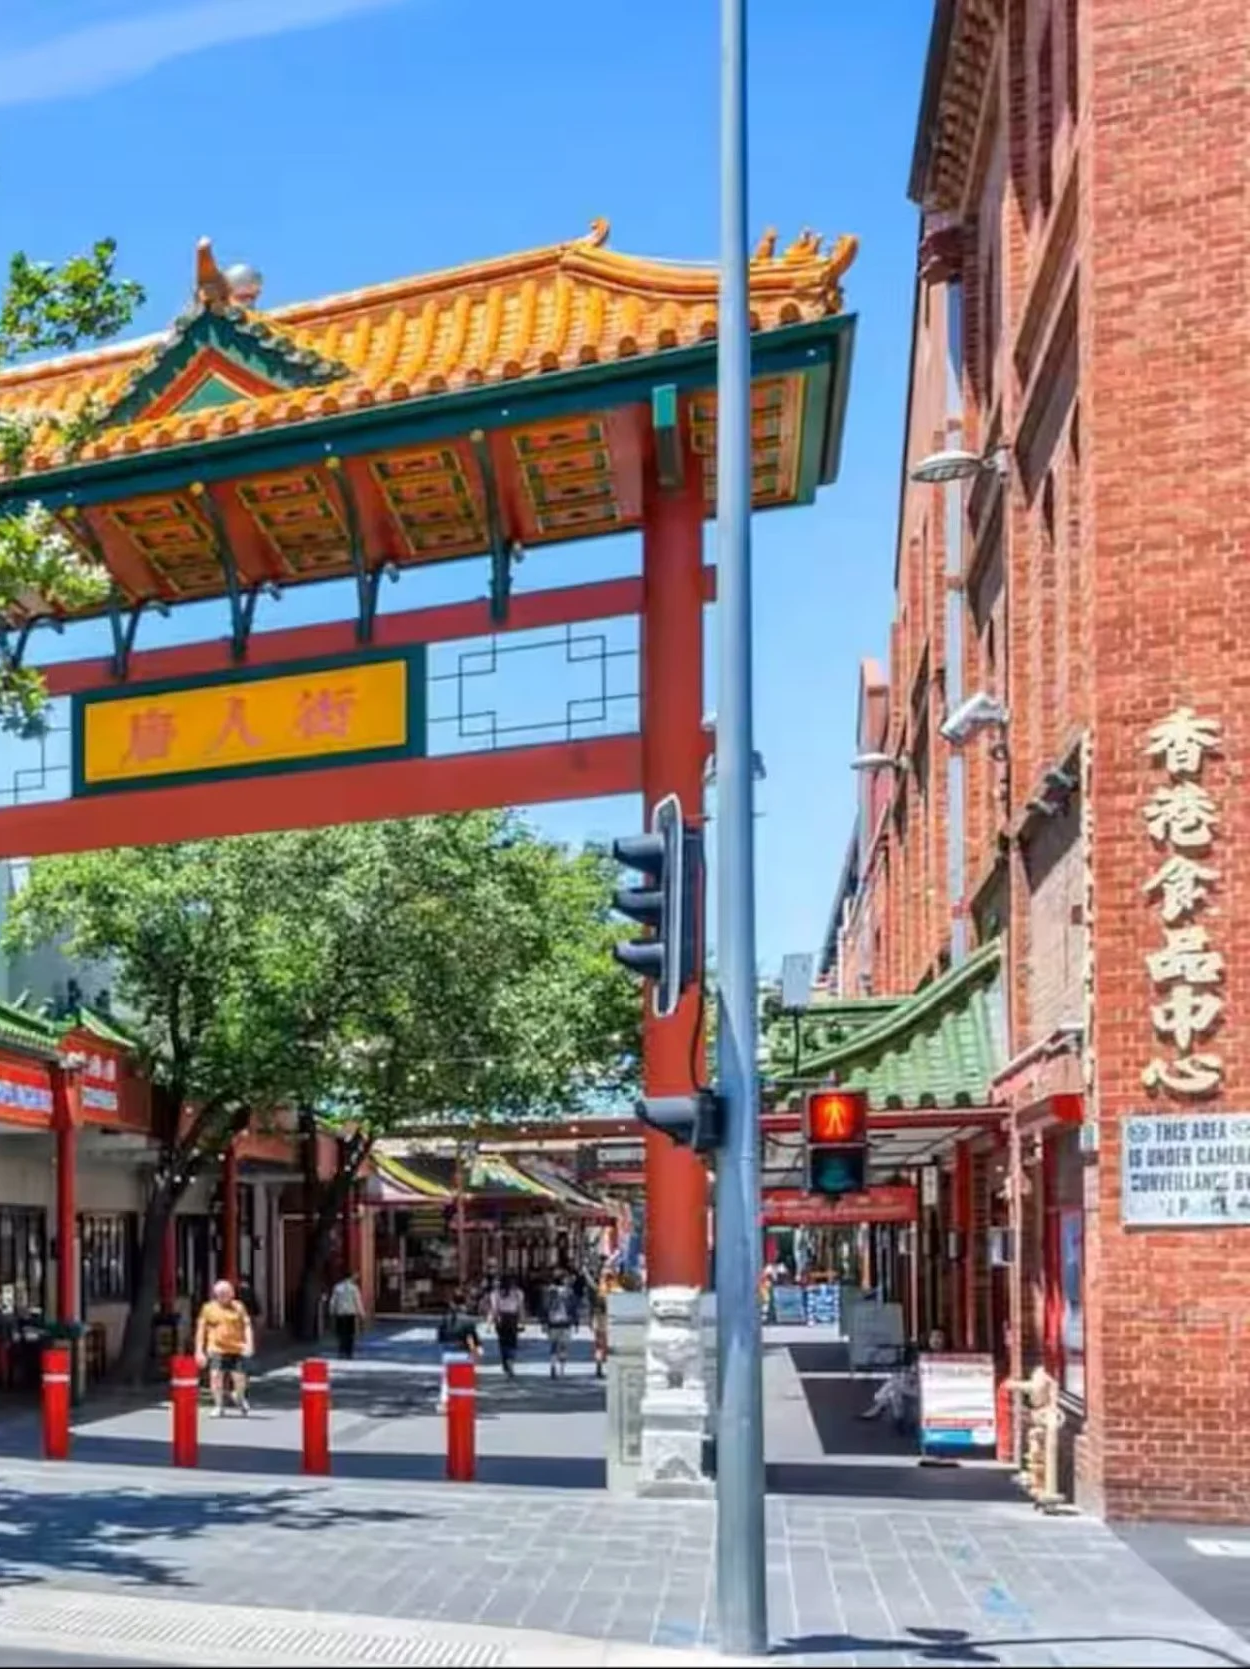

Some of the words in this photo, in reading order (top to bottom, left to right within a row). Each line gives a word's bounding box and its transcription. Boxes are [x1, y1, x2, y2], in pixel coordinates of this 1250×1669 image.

[120, 687, 357, 769] 唐人街
[1142, 706, 1224, 1095] 香港食品中心
[1156, 1121, 1187, 1141] THIS
[1191, 1120, 1227, 1139] AREA
[1129, 1148, 1142, 1168] IS
[1146, 1146, 1192, 1167] UNDER
